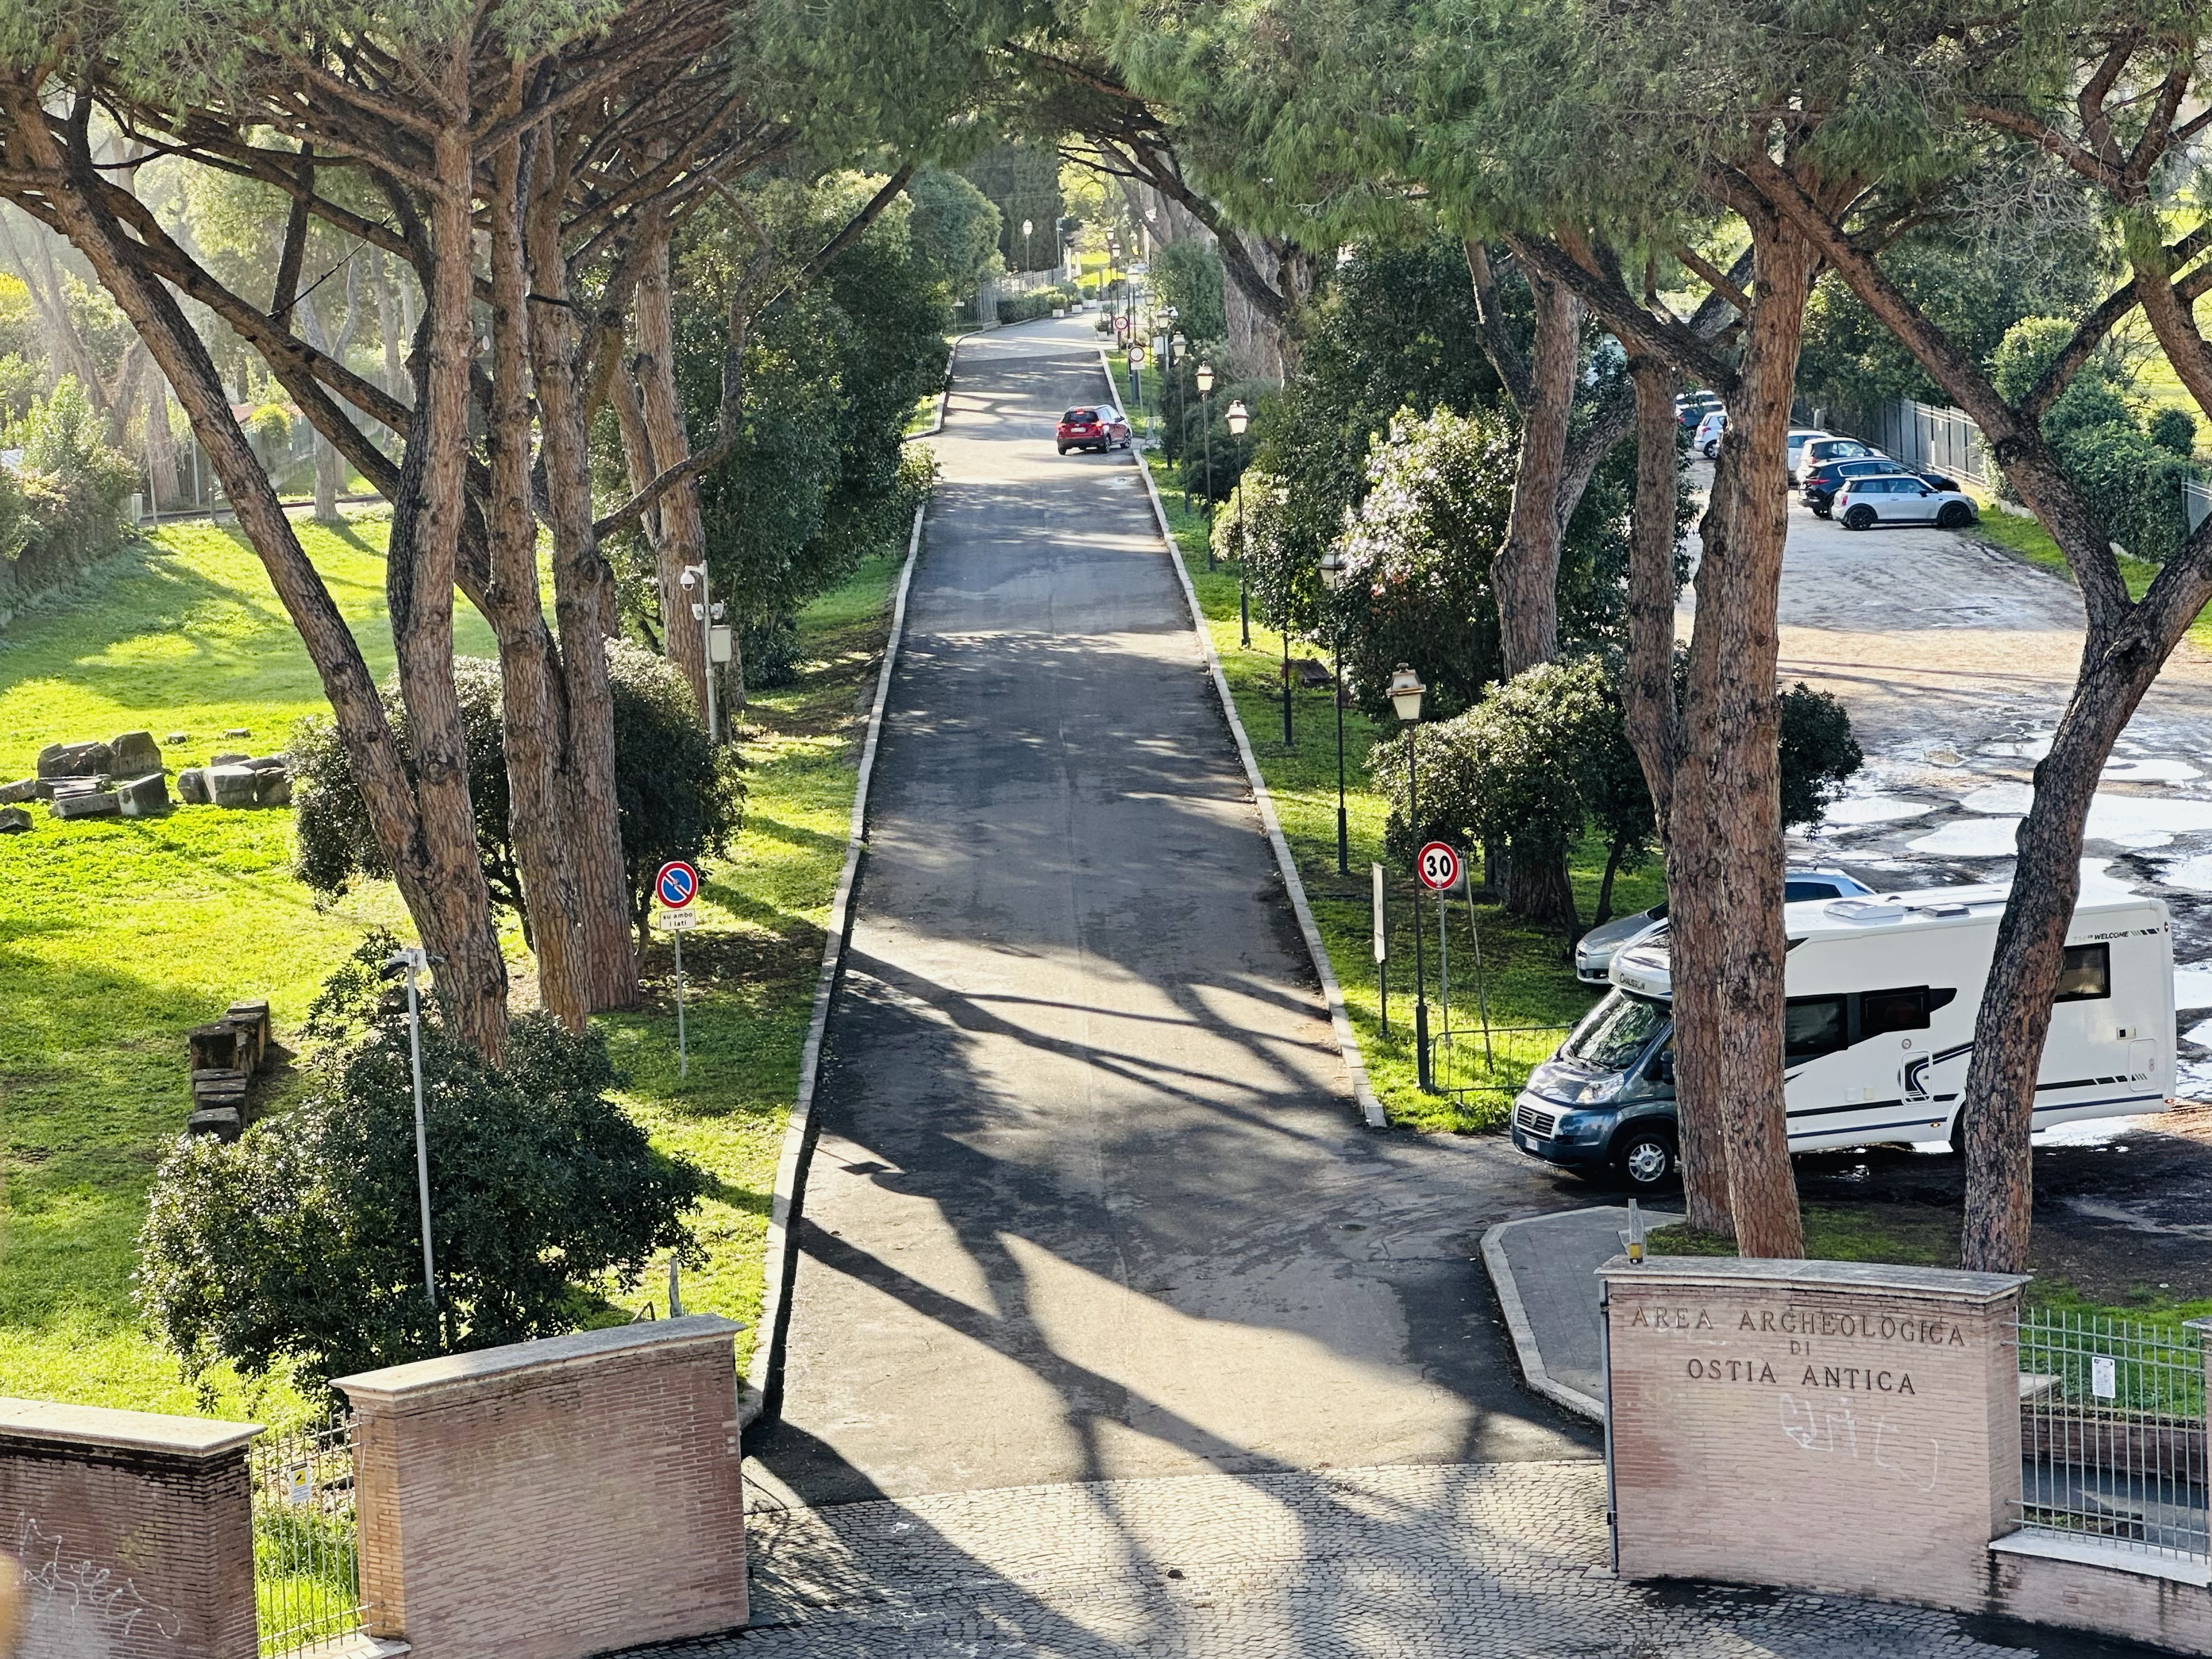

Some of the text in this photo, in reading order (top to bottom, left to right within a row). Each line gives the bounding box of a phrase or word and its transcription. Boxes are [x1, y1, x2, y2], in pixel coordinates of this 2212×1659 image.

[1426, 855, 1451, 877] 30
[2095, 931, 2129, 940] WELCOME
[1632, 1306, 1965, 1346] AREA ARCHEOLOGICA
[1790, 1340, 1810, 1355] DI
[1687, 1358, 1916, 1395] OSTIA ANTICA
